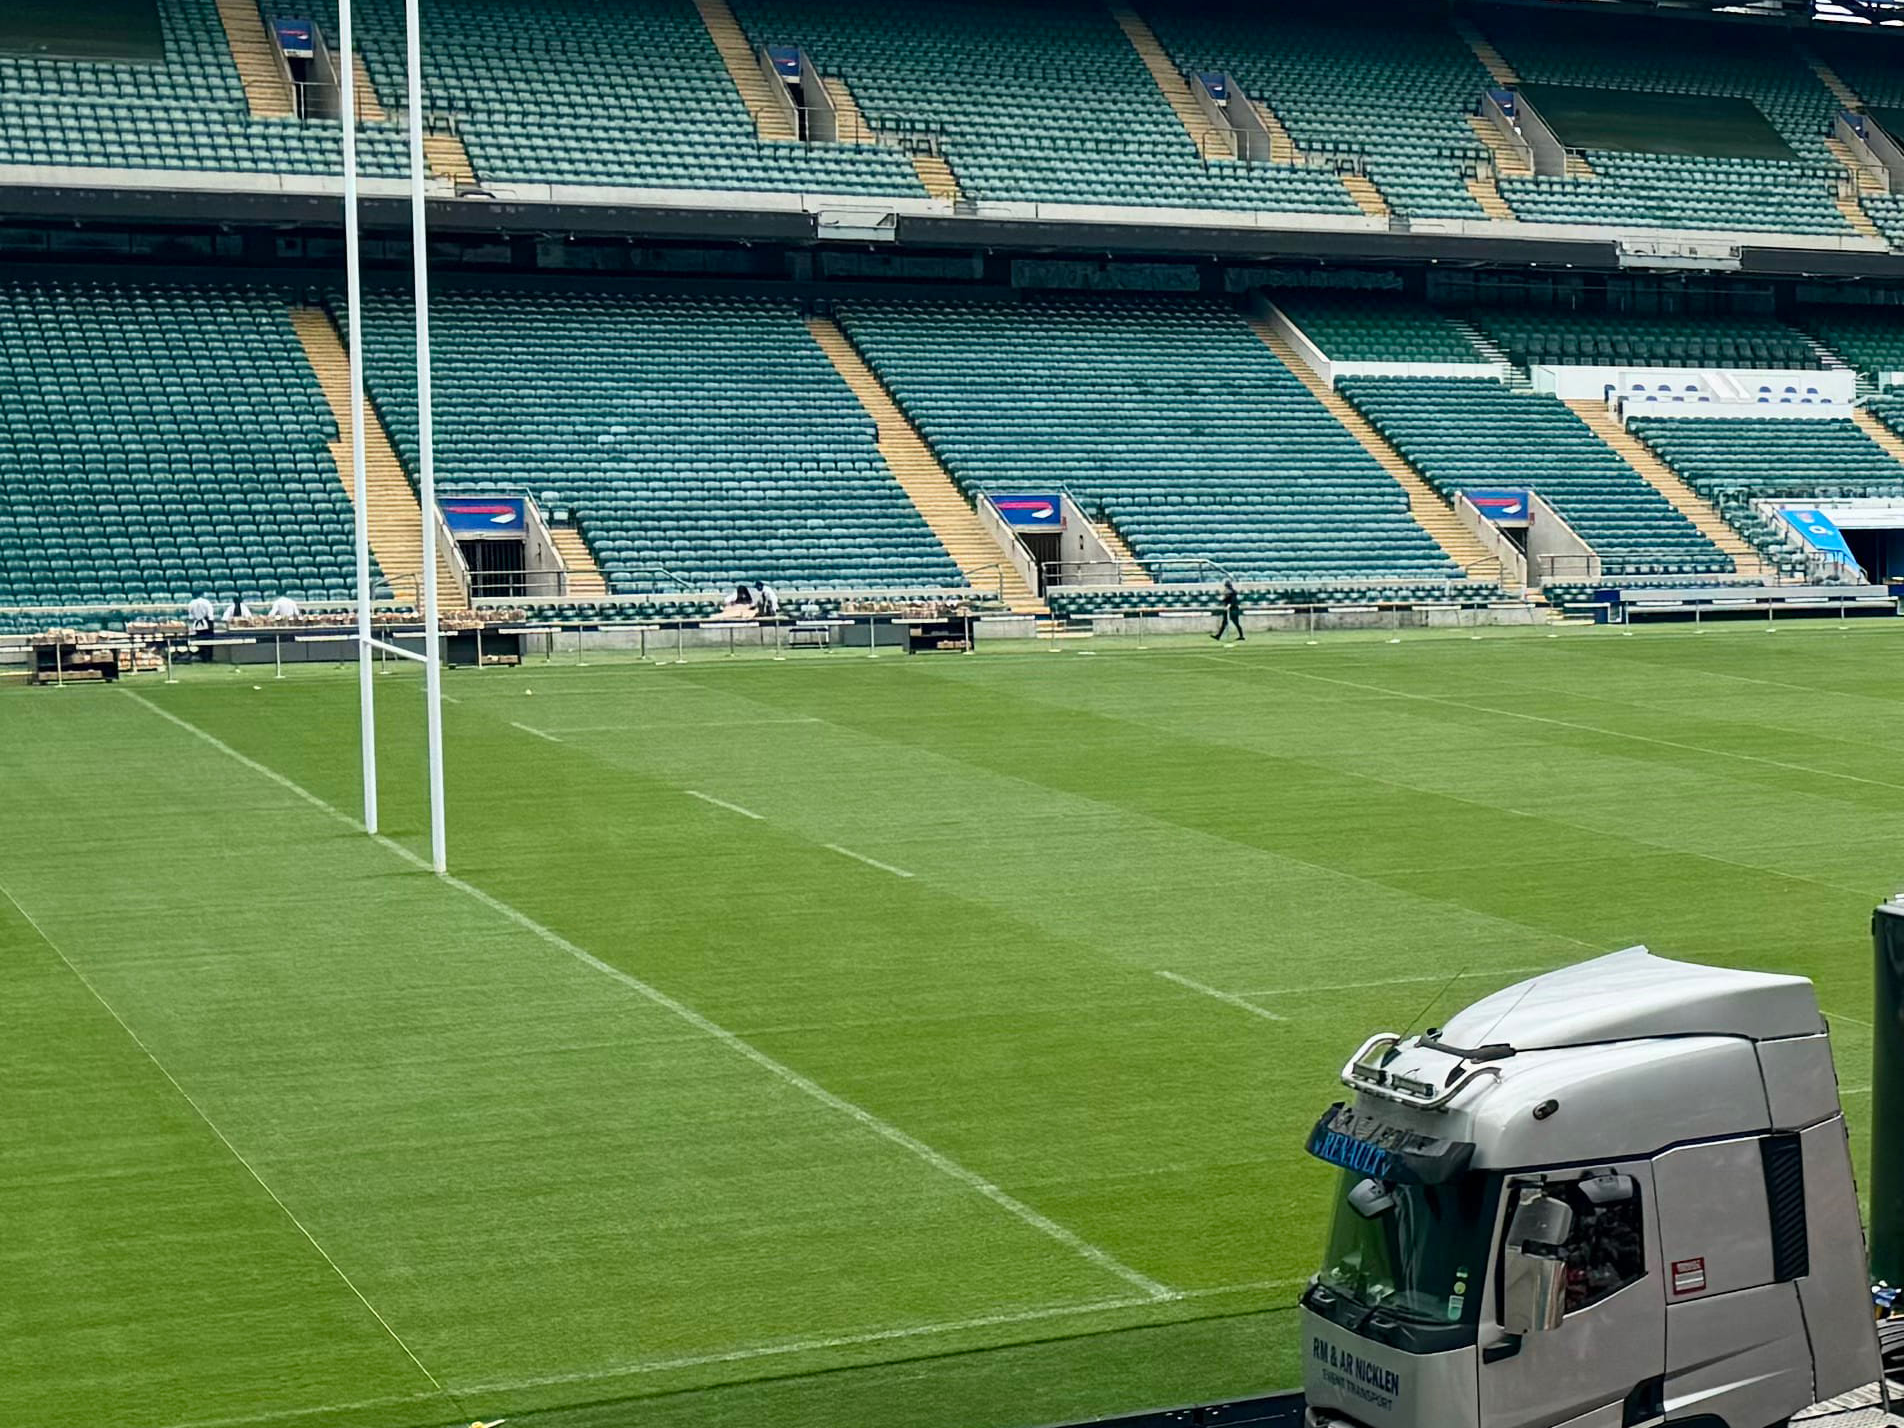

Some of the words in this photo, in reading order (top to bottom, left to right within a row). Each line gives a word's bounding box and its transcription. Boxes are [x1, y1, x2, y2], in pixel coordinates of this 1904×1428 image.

[1320, 1130, 1388, 1175] RENAULT
[1313, 1336, 1329, 1364] RM
[1330, 1344, 1339, 1368] &
[1340, 1349, 1354, 1376] AR
[1355, 1356, 1399, 1397] NICKLEN
[1321, 1367, 1346, 1389] EVENT
[1346, 1378, 1393, 1412] TRANSPORT
